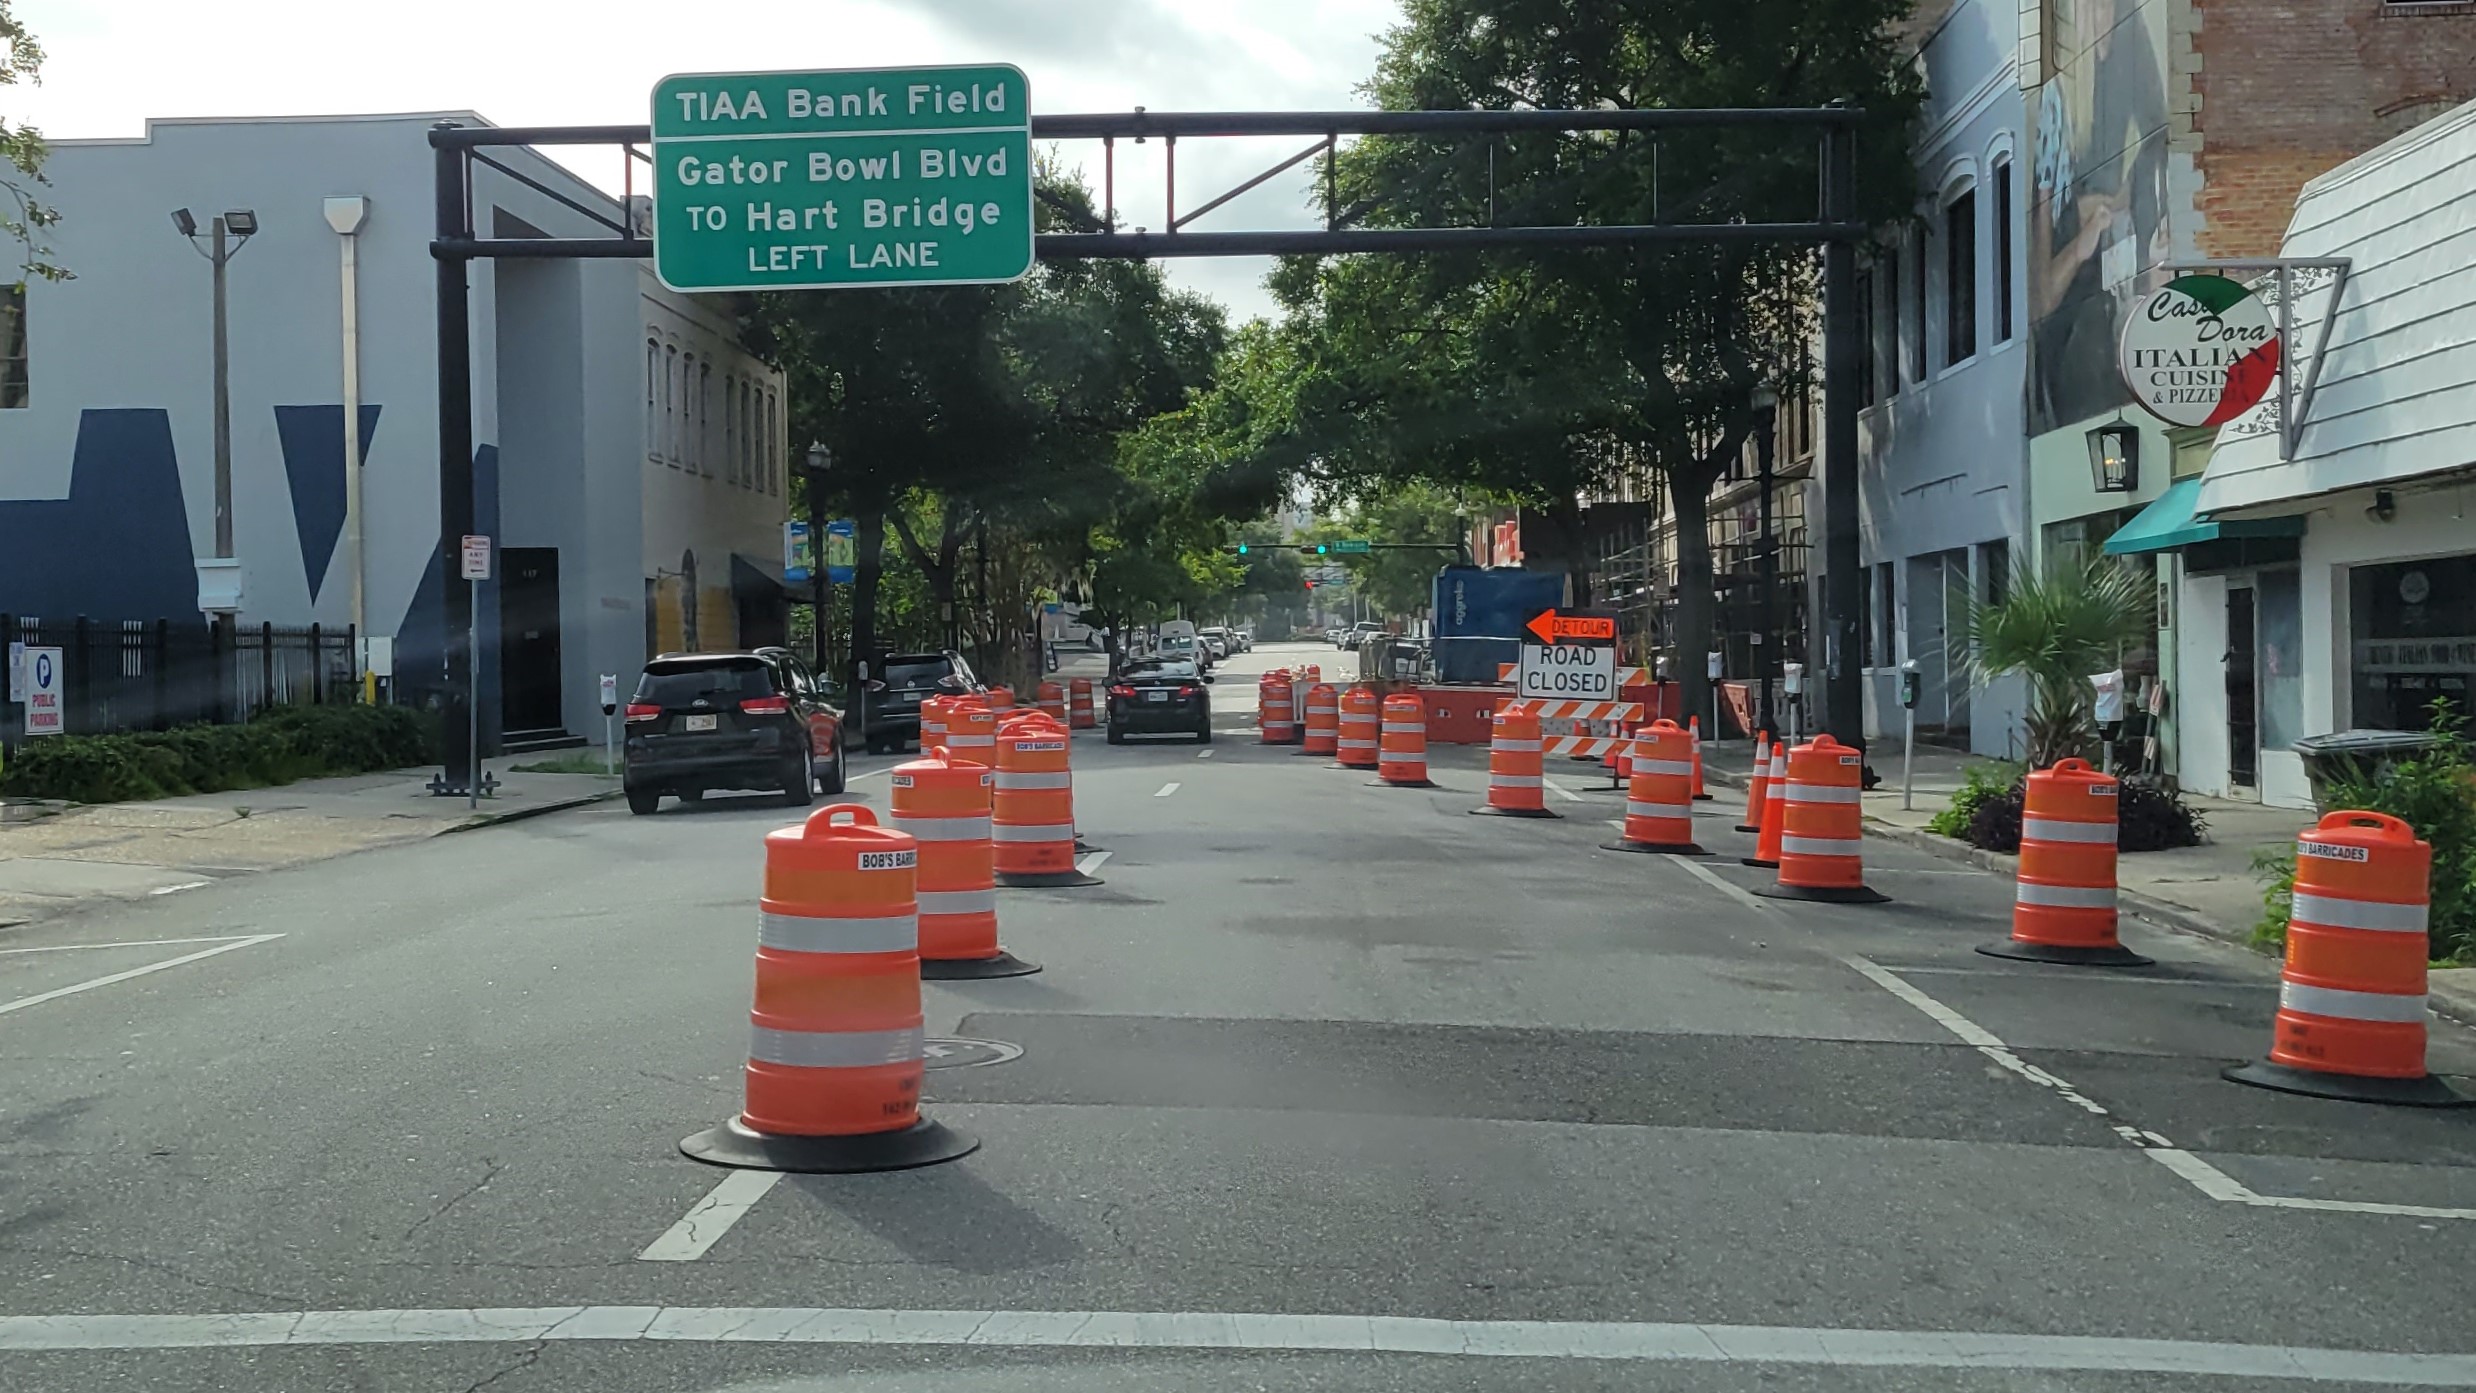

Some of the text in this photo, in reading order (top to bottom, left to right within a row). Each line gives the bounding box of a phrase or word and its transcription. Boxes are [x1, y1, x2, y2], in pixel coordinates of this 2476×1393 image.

[676, 83, 1006, 121] TIAA Bank Field
[677, 147, 1007, 186] Gator Bowl Blvd
[686, 197, 1001, 235] TO Hart Bridge
[748, 242, 940, 272] LEFT LANE
[2196, 315, 2269, 342] Dora
[2152, 391, 2164, 404] &
[1552, 618, 1609, 635] DETOUR
[1540, 646, 1596, 666] ROAD
[1527, 671, 1608, 693] CLOSED
[862, 853, 894, 868] BOB'S
[2308, 843, 2365, 861] BARRICADES
